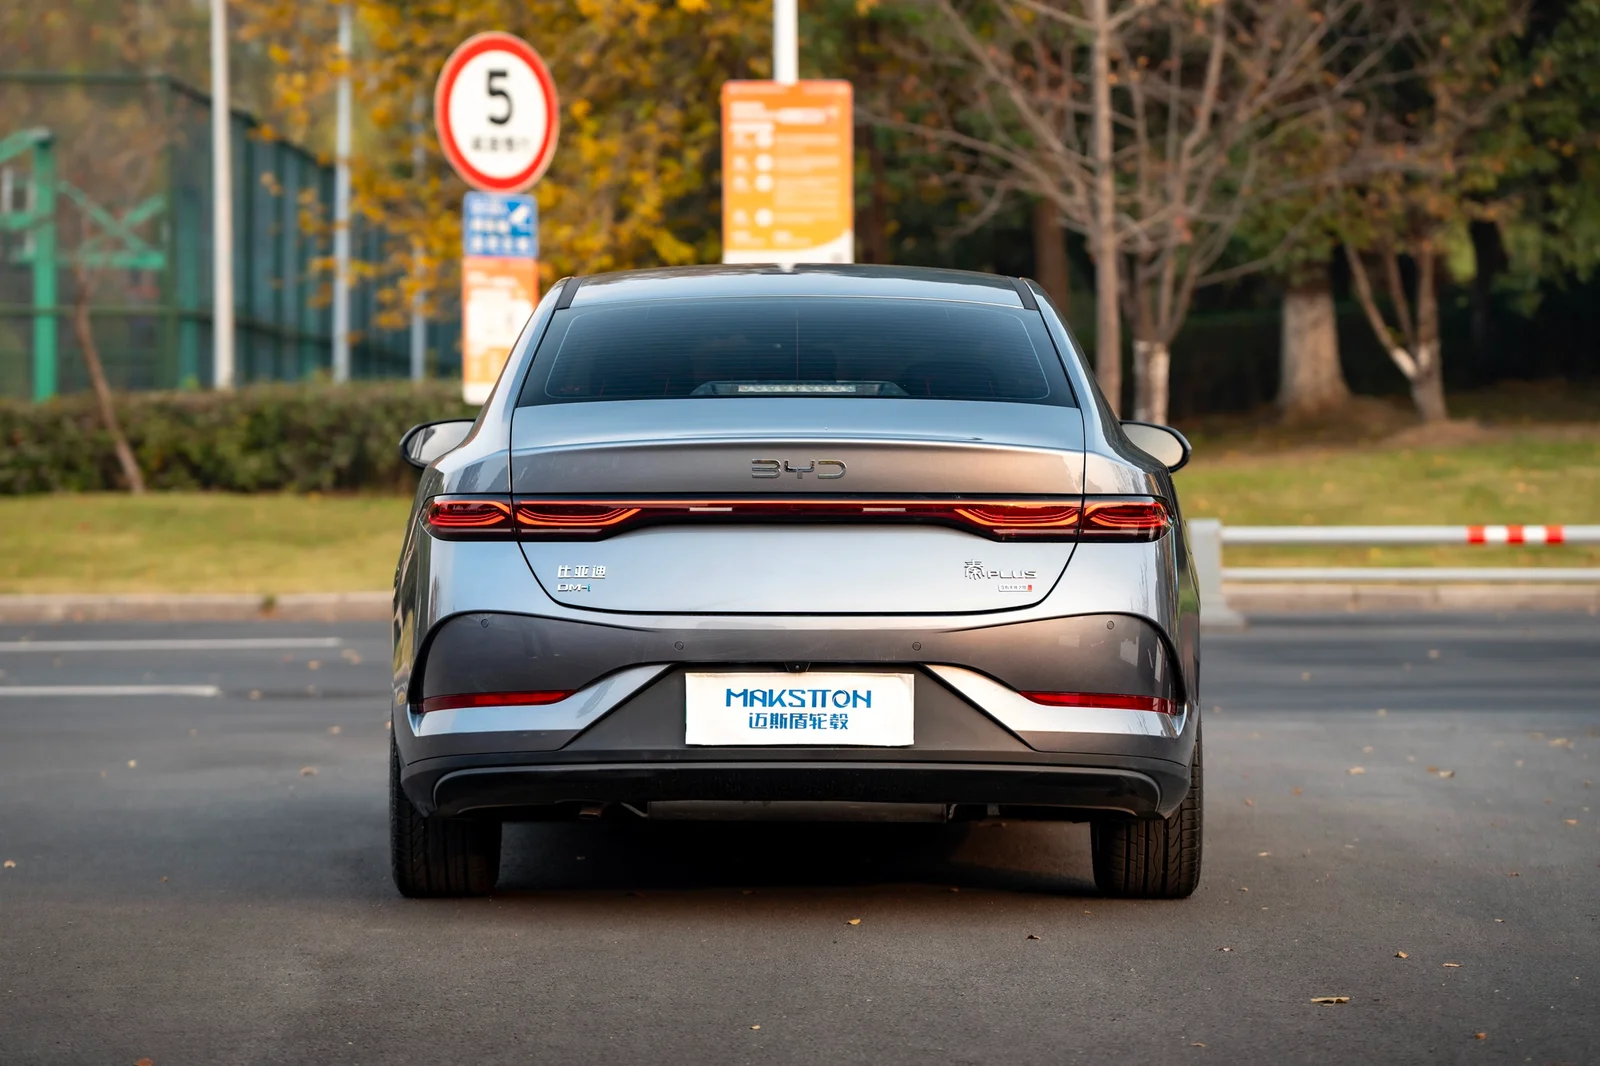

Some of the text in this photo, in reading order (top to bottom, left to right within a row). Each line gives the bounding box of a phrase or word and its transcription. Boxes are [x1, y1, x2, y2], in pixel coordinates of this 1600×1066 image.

[487, 69, 513, 125] 5
[752, 459, 847, 479] BYD
[557, 565, 606, 579] 比亚迪
[557, 584, 591, 592] DM-i
[725, 688, 872, 708] MAKSTTON
[748, 712, 849, 730] 迈斯盾轮毂
